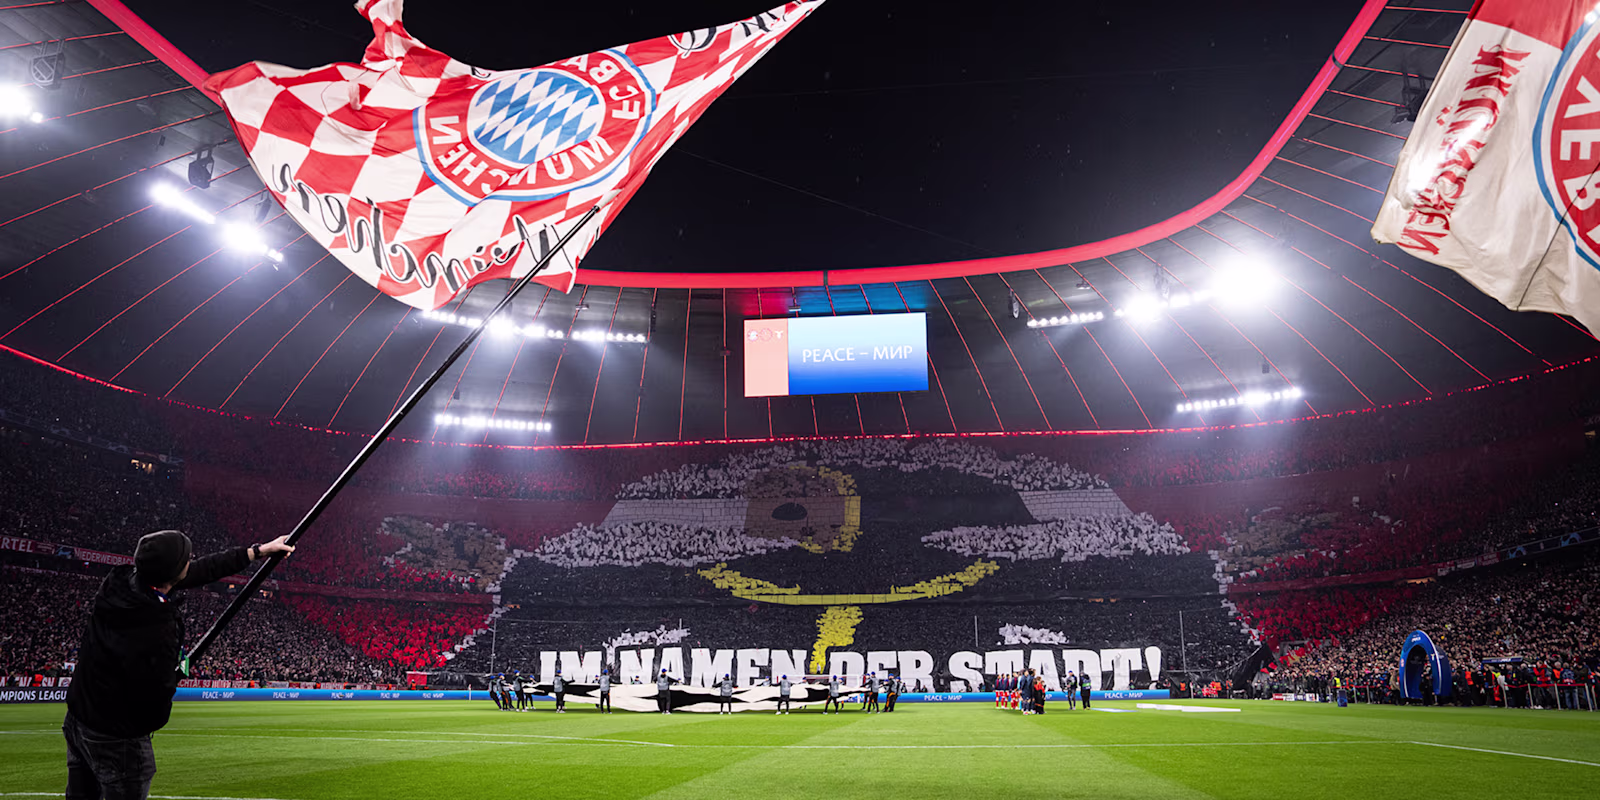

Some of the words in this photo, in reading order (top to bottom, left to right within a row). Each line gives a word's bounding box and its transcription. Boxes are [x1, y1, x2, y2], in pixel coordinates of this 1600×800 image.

[802, 347, 856, 363] PEACE
[873, 345, 913, 361] МИР
[540, 650, 602, 683] IM
[618, 647, 807, 687] NAMEN
[829, 650, 936, 692] DER
[948, 645, 1162, 692] STADT!
[0, 690, 36, 701] MPIONS
[38, 690, 67, 701] LEAGU
[202, 691, 218, 699] PEACE
